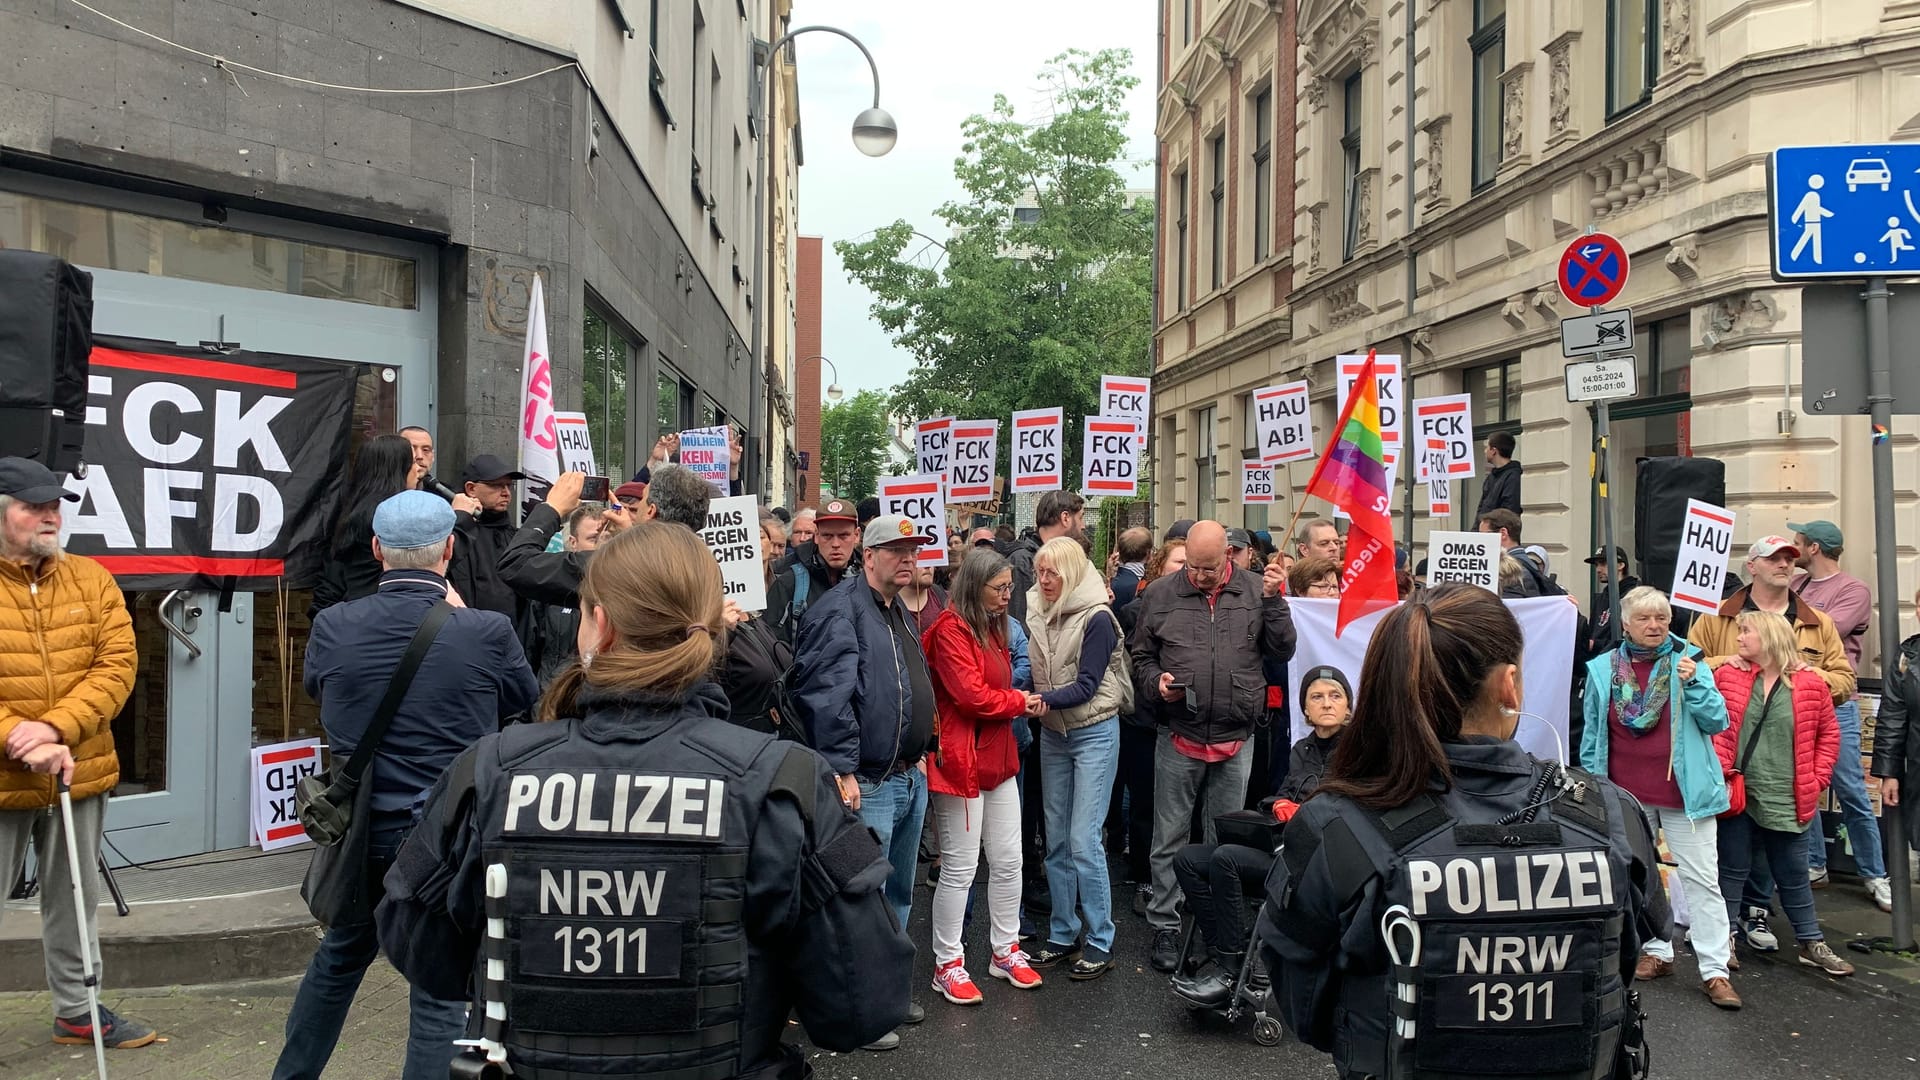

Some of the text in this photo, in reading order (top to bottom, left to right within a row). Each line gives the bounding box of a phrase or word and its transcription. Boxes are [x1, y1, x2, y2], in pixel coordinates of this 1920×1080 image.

[1582, 372, 1623, 383] 04.05.2024
[1582, 381, 1626, 393] 15:00-01:00
[1108, 394, 1143, 412] FCK
[1260, 396, 1306, 422] HAU
[1423, 415, 1464, 436] FCK
[560, 429, 590, 450] HAU
[681, 435, 726, 447] MÜLHEIM
[922, 431, 950, 452] FCK
[1018, 428, 1055, 450] FCK
[1092, 435, 1131, 454] FCK
[1267, 424, 1304, 448] AB!
[682, 450, 714, 464] KEIN
[955, 440, 990, 460] FCK
[922, 454, 948, 474] NZ
[1018, 453, 1056, 474] NZS
[1088, 459, 1132, 477] AFD
[1430, 453, 1447, 474] FCK
[953, 464, 989, 484] NZS
[1247, 470, 1271, 481] FCK
[1245, 484, 1272, 494] AFD
[1431, 480, 1448, 499] NZS
[59, 464, 285, 553] AFD
[889, 497, 936, 519] FCK
[706, 510, 744, 528] MAS
[1687, 521, 1730, 554] HAU
[712, 545, 755, 563] CHTS
[1442, 543, 1486, 556] OMAS
[1438, 557, 1488, 570] GEGEN
[1434, 571, 1491, 585] RECHTS
[1682, 560, 1719, 591] AB!
[722, 581, 747, 595] öln
[504, 773, 725, 837] POLIZEI
[540, 869, 667, 916] NRW
[1408, 851, 1614, 915] POLIZEI
[554, 926, 648, 974] 1311
[1456, 934, 1573, 974] NRW
[1468, 980, 1554, 1022] 1311
